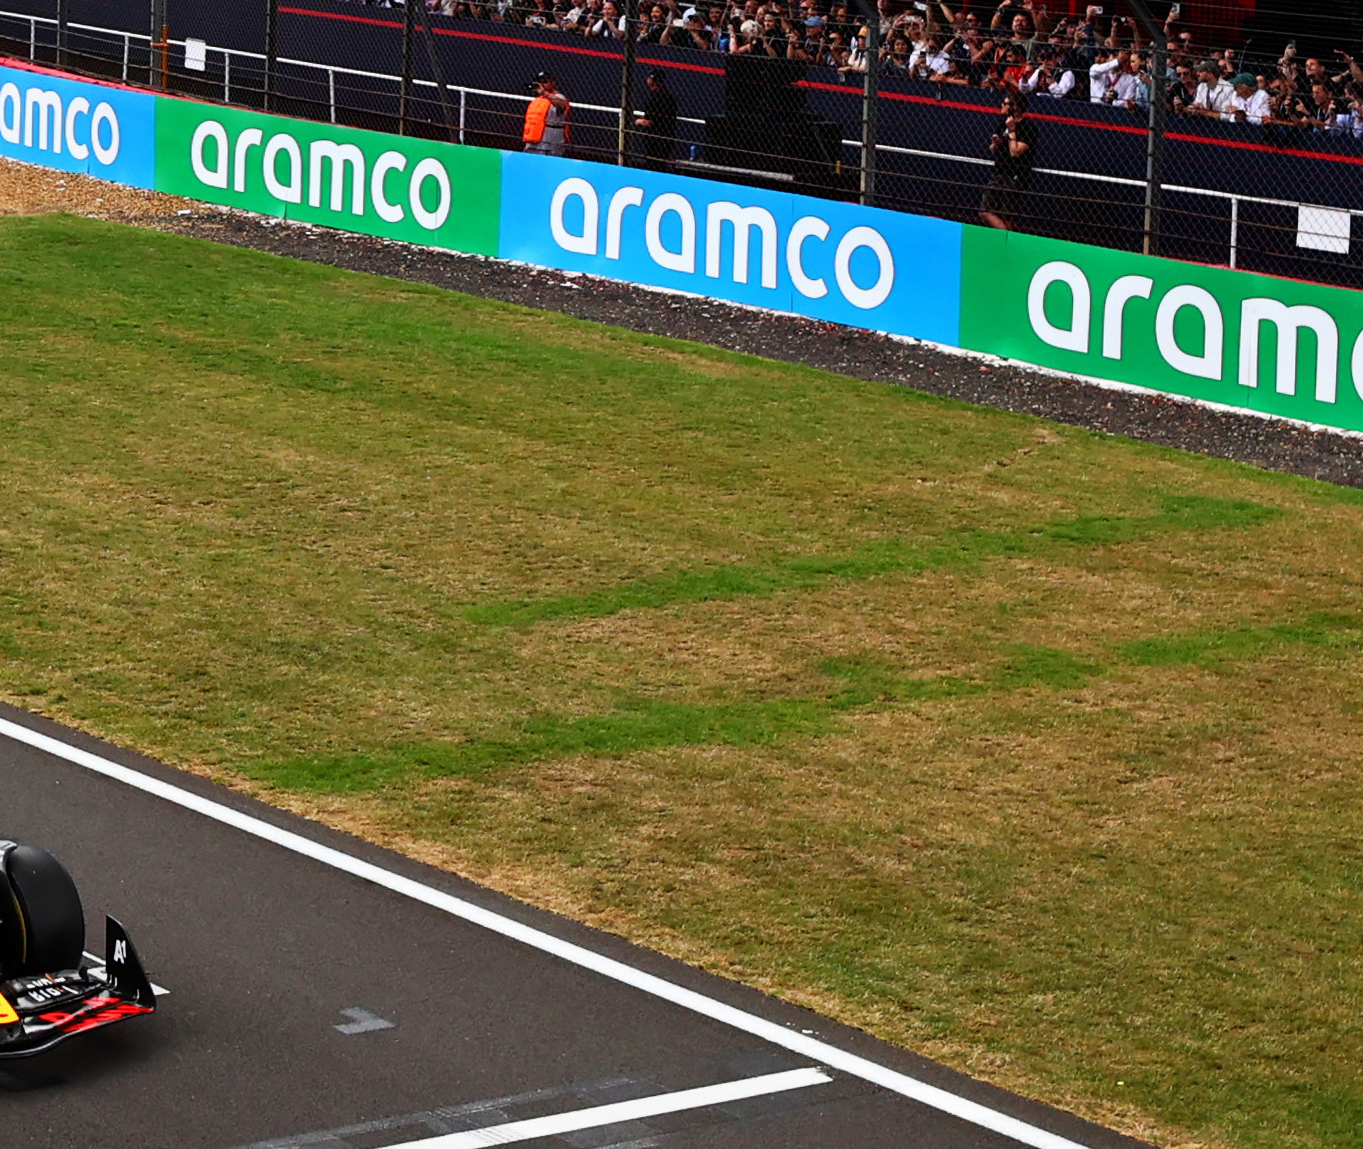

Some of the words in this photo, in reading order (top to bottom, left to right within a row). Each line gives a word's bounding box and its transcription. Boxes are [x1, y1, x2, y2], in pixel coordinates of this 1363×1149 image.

[190, 120, 451, 230] aramco
[549, 177, 895, 310] aramco
[1028, 261, 1363, 404] aram
